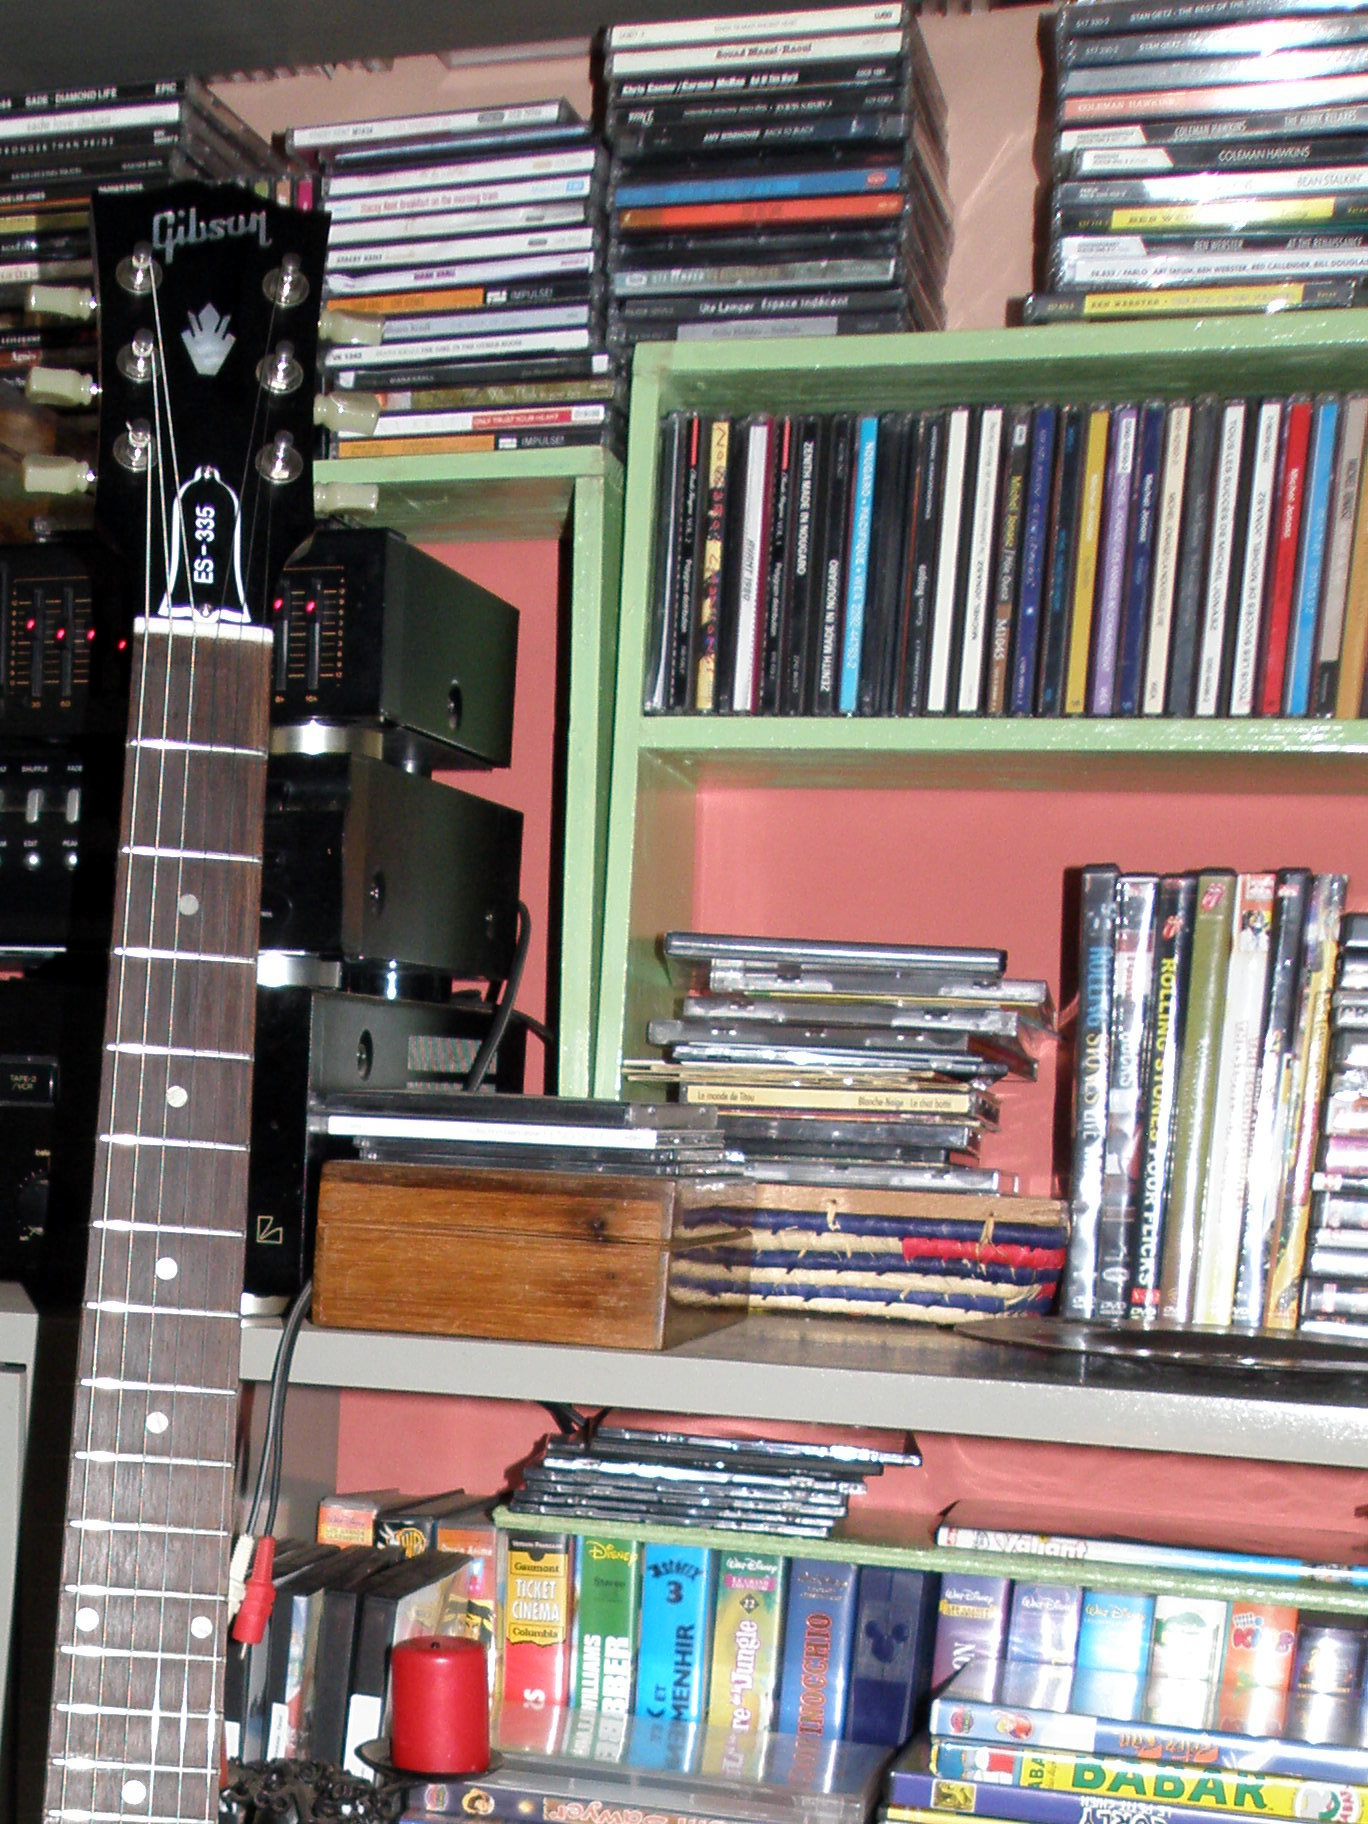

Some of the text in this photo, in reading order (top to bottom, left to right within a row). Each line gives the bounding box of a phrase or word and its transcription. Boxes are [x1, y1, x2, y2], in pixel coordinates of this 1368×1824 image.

[25, 82, 177, 107] SADE DIAMOND LIFE EPIC
[1218, 146, 1310, 161] COLEMAN HAWKINS
[152, 207, 272, 265] Gibson
[510, 288, 553, 300] IMPULSE!
[522, 436, 564, 447] IMPULSE!
[859, 441, 874, 497] NOUGARO
[796, 441, 814, 576] ZENITH MADE IN NOUGARO
[855, 506, 870, 565] PACIFIQUE
[193, 504, 216, 584] ES-335
[820, 560, 840, 692] ZENITH MADE IN NOUGARO
[1156, 957, 1175, 1048] ROLLING
[1136, 1209, 1157, 1288] FLICKS
[514, 1562, 560, 1574] Gaumont
[516, 1578, 556, 1600] TICKET
[666, 1580, 683, 1604] 3
[512, 1604, 560, 1621] CINEMA
[512, 1626, 559, 1639] Columbia
[672, 1624, 695, 1722] MENHIR
[1071, 1756, 1268, 1810] BABAR
